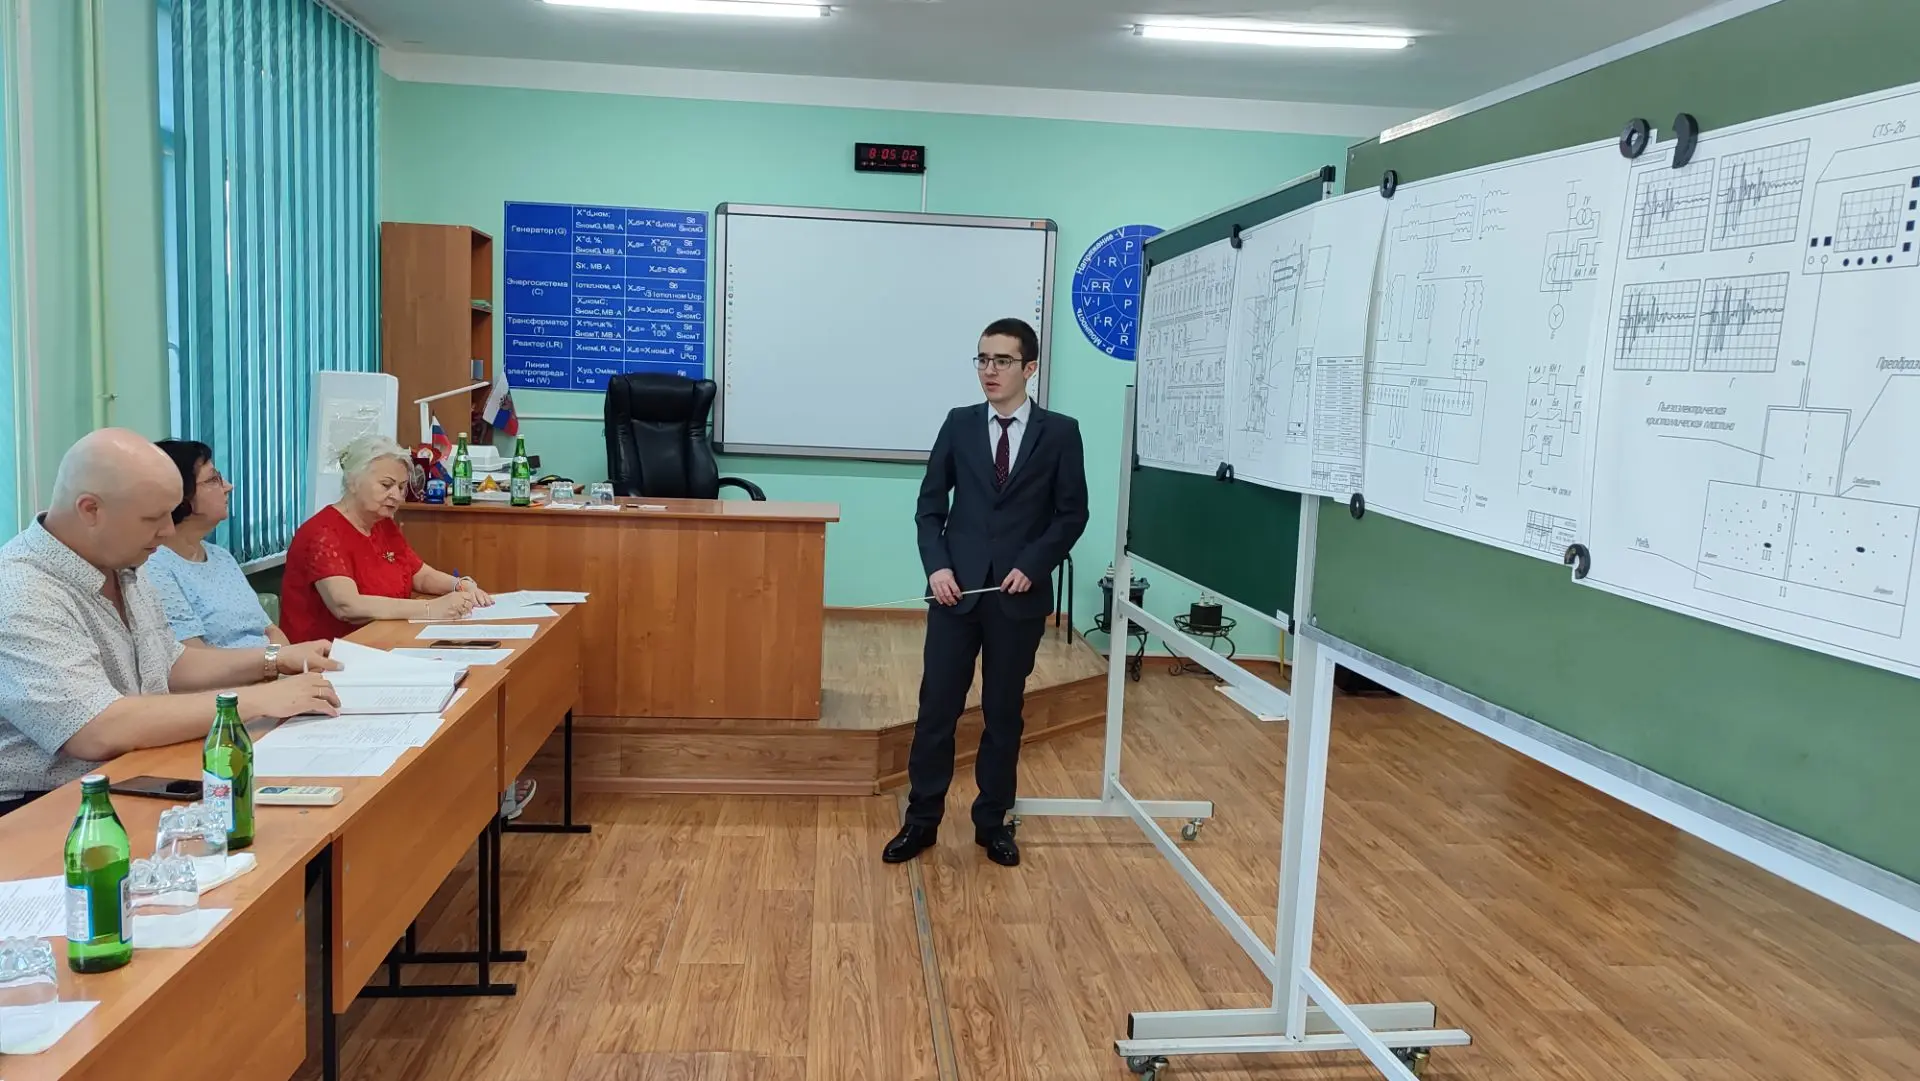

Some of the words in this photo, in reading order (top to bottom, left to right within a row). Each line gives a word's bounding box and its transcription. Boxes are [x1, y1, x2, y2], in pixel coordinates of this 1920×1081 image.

[511, 224, 554, 235] Генератор
[1126, 241, 1134, 252] P
[506, 278, 568, 288] Энергосистема
[1124, 278, 1132, 288] V
[1124, 299, 1132, 310] P
[508, 317, 568, 327] Трансформатор
[512, 340, 546, 350] Реактор
[1120, 335, 1128, 346] R
[525, 360, 549, 368] Линия
